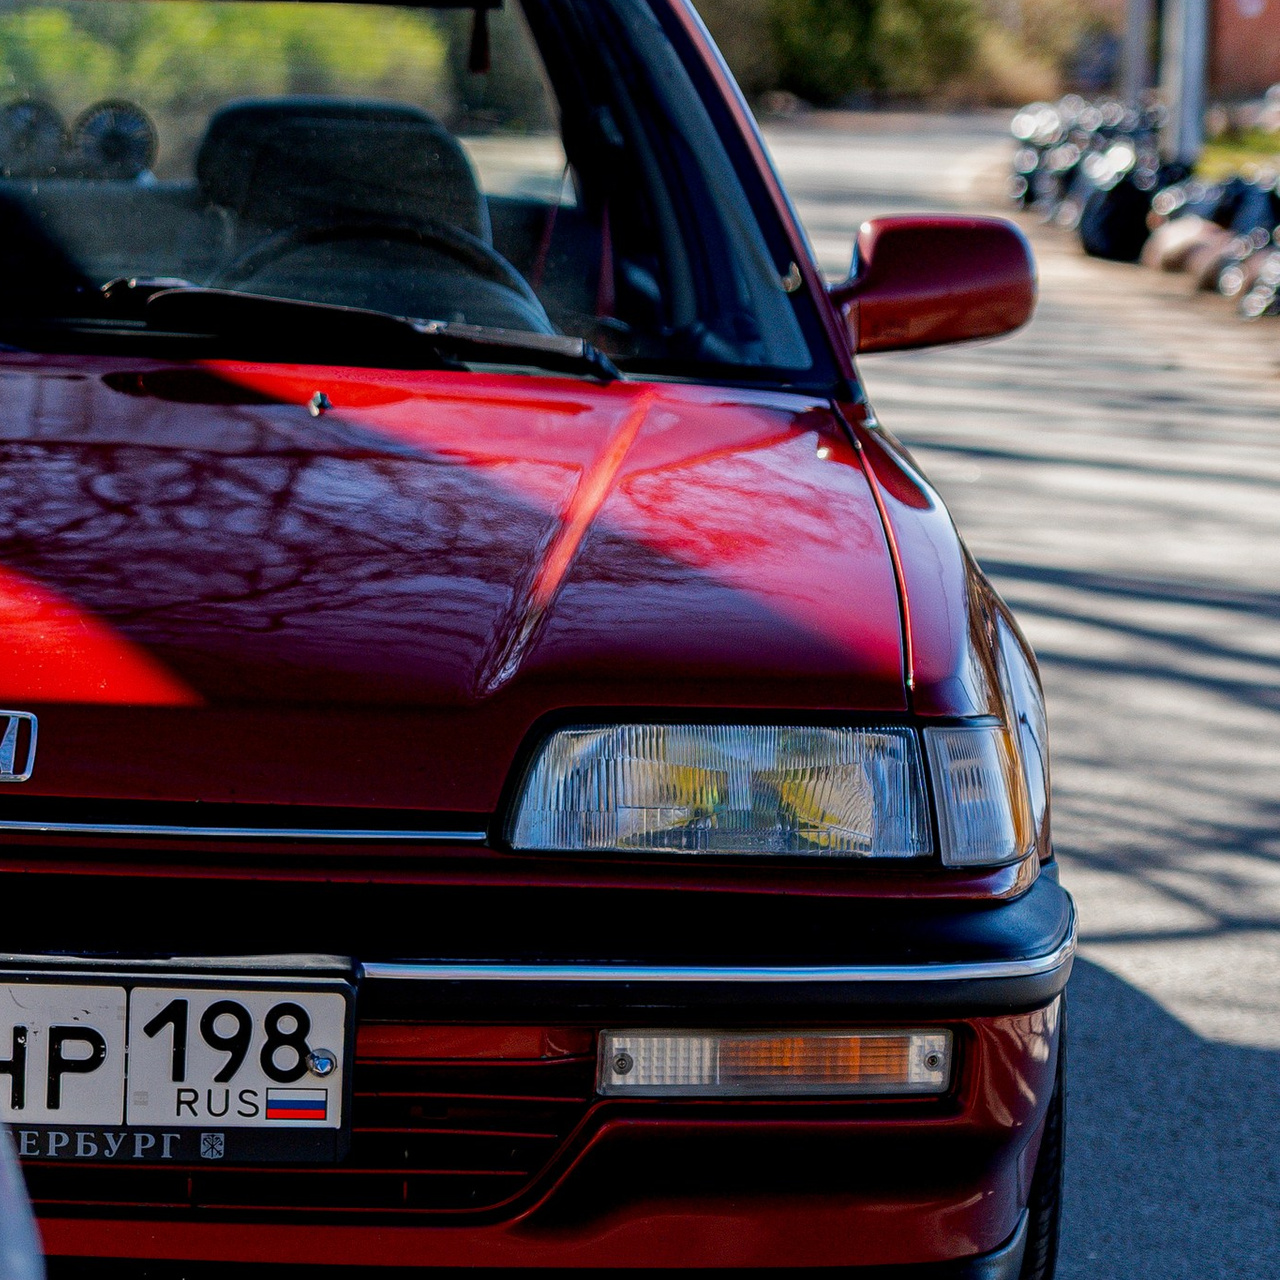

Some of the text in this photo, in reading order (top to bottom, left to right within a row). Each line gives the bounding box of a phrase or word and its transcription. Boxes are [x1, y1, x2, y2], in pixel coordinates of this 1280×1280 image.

[143, 999, 312, 1083] 198
[176, 1087, 260, 1118] RUS
[7, 1129, 181, 1158] ЕРБУРГ
